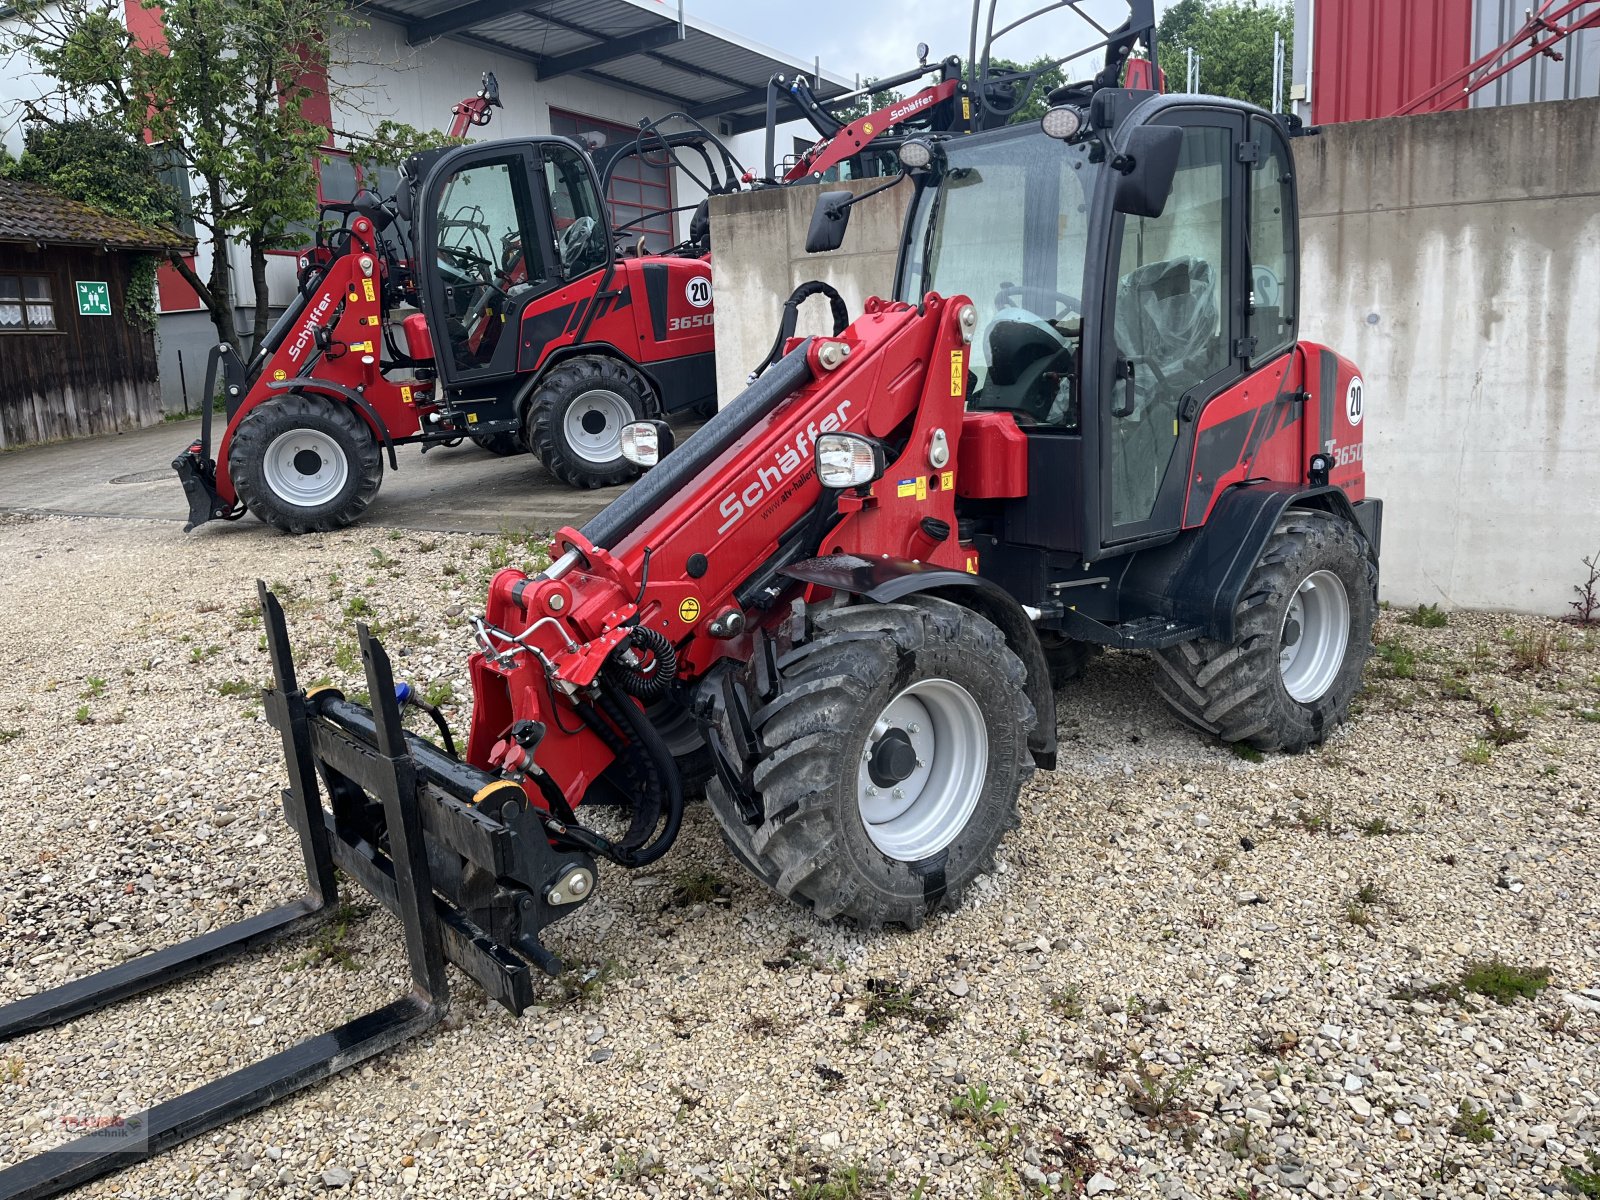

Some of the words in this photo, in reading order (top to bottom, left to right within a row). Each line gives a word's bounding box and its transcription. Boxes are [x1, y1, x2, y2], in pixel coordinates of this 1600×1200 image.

[889, 95, 934, 121] Schäffer
[691, 282, 709, 302] 20
[288, 293, 332, 362] Schäffer
[669, 313, 714, 331] 3650
[1350, 385, 1361, 416] 20
[717, 399, 852, 535] Schäffer
[760, 466, 817, 520] www.atv-hallert
